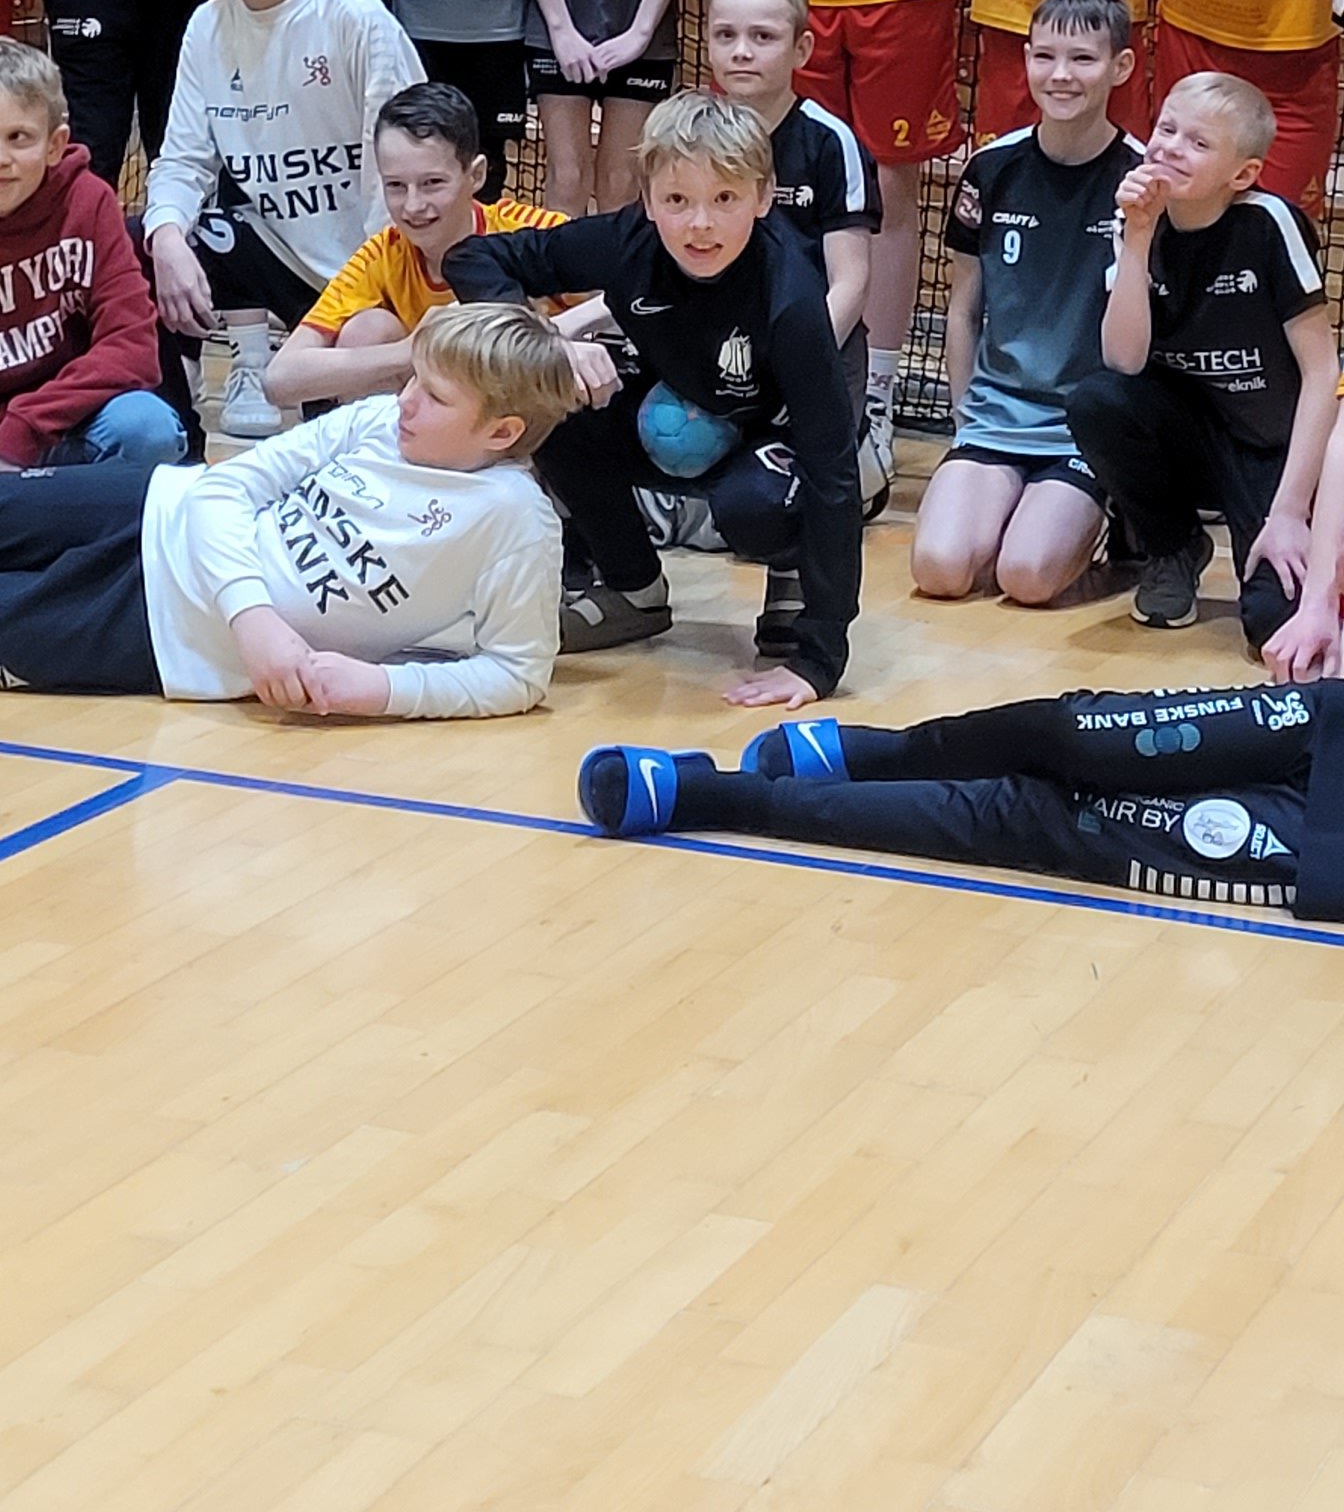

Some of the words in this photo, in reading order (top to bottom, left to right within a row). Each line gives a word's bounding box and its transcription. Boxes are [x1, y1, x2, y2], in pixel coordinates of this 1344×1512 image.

[892, 118, 911, 148] 2
[225, 142, 363, 184] YNSKE
[1002, 229, 1021, 264] 9
[1150, 347, 1261, 371] CES-TECH
[1076, 711, 1148, 731] BANK
[1093, 797, 1136, 825] AIR
[1142, 808, 1181, 833] BY
